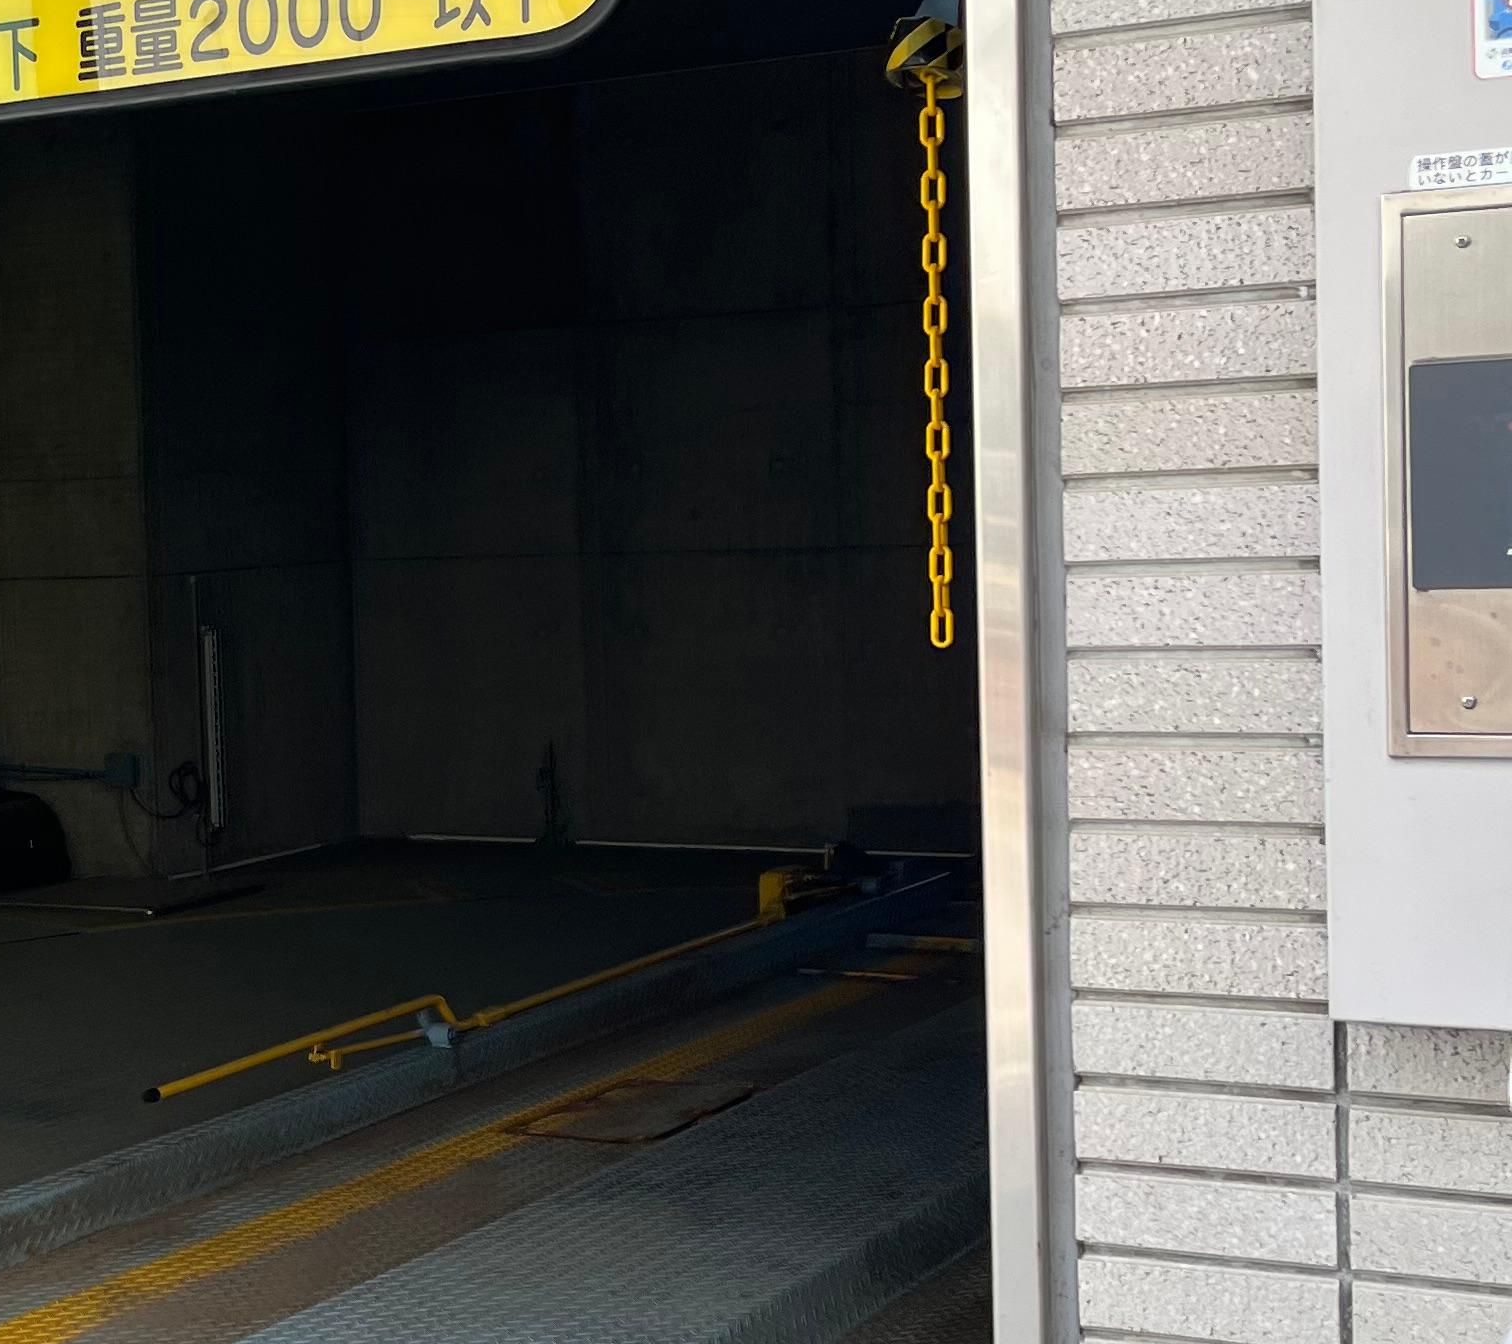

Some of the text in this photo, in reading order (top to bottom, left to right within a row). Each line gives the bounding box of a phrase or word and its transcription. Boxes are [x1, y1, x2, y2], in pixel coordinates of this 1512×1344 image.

[1417, 150, 1512, 172] 操作盤の蓋が
